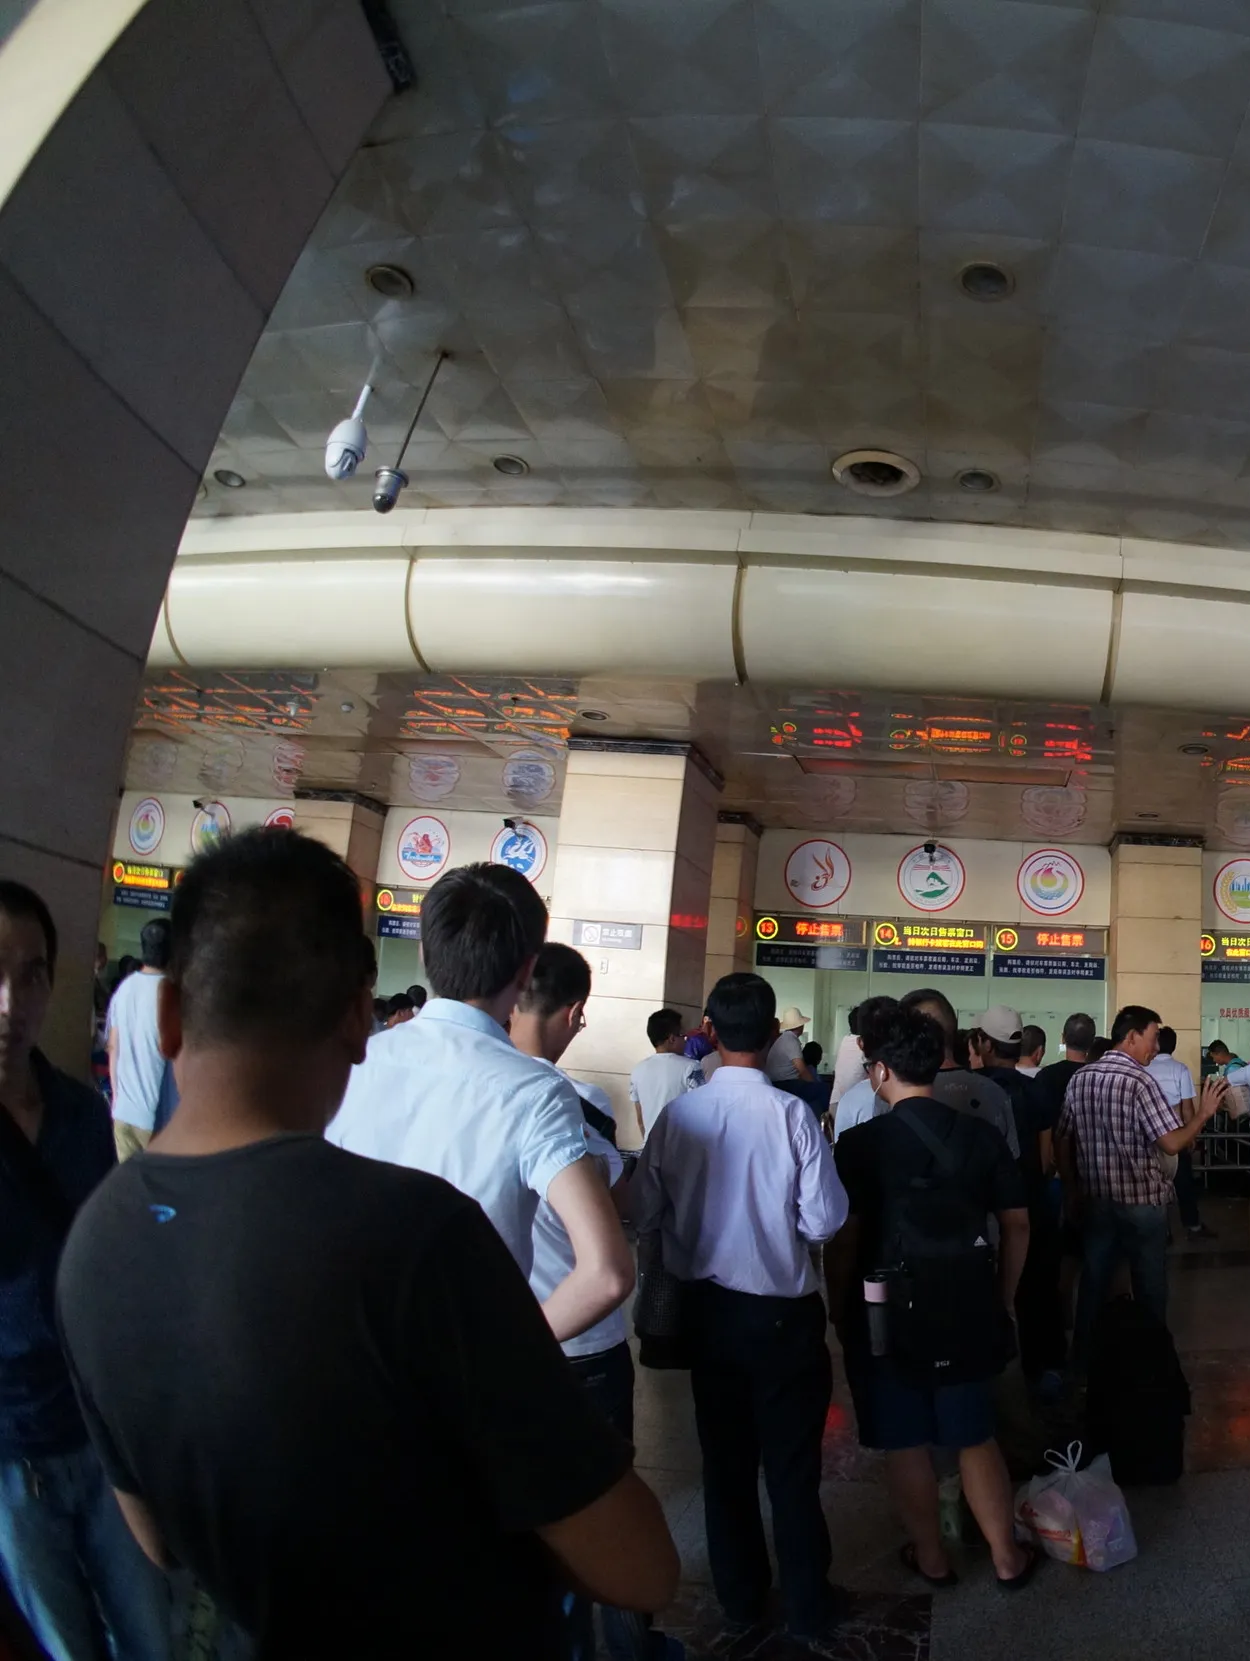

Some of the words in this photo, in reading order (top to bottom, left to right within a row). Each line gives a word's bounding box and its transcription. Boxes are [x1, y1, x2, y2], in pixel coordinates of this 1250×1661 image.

[760, 922, 774, 934] 13
[795, 921, 843, 936] 停止售票
[879, 927, 894, 939] 14
[903, 925, 974, 938] 当日次日售票窗口
[1000, 933, 1014, 945] 15
[1036, 932, 1084, 946] 停止售票
